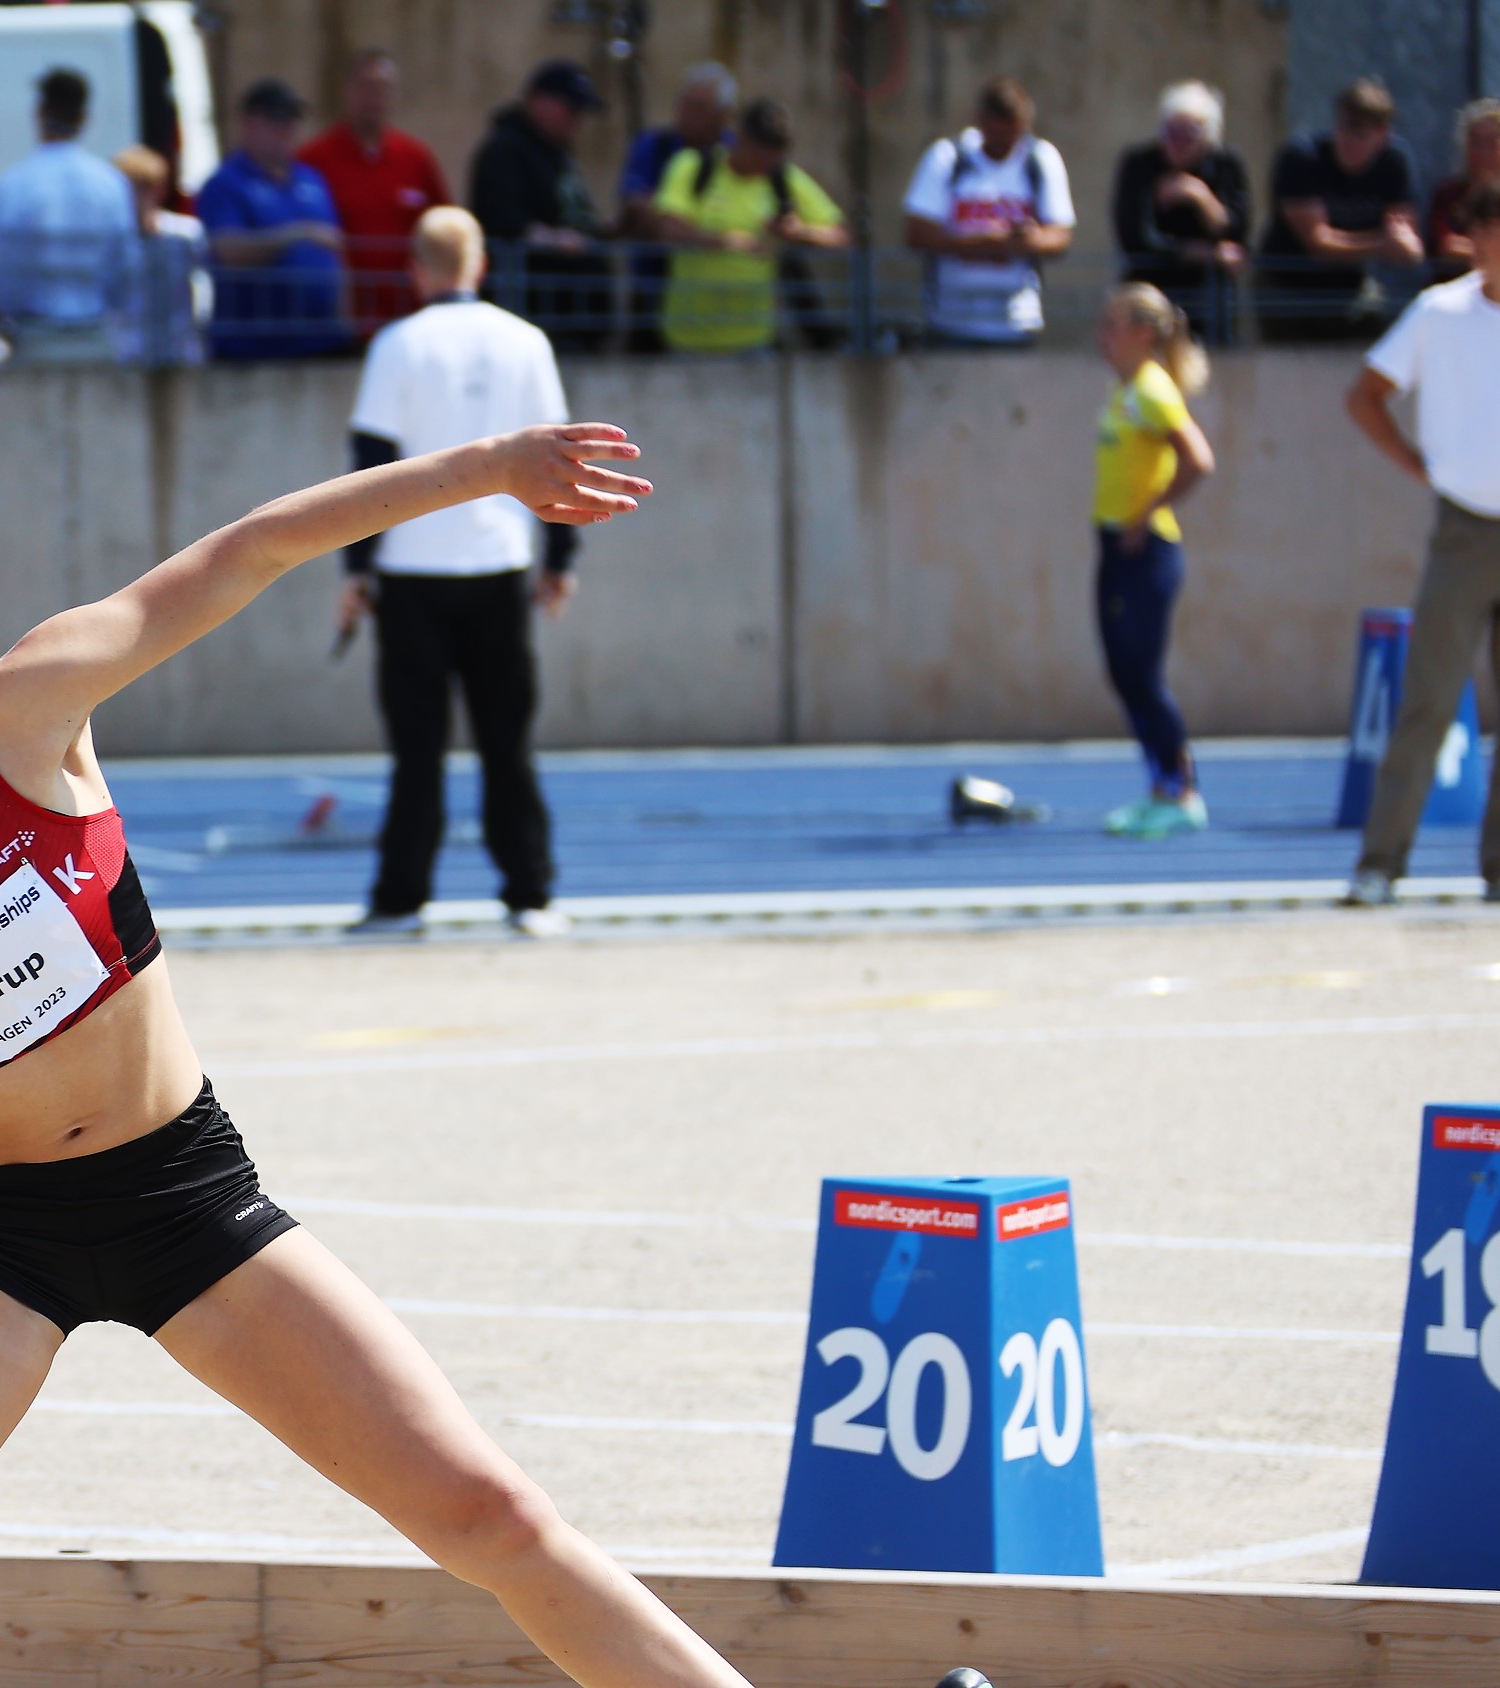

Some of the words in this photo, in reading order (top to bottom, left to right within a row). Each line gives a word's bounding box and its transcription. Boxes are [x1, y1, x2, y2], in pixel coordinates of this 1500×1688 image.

[34, 986, 68, 1019] 2023
[234, 1200, 261, 1221] CRAFT
[847, 1200, 978, 1230] nordicsport.com
[1420, 1227, 1500, 1392] 1
[811, 1326, 973, 1482] 20
[998, 1316, 1085, 1468] 20
